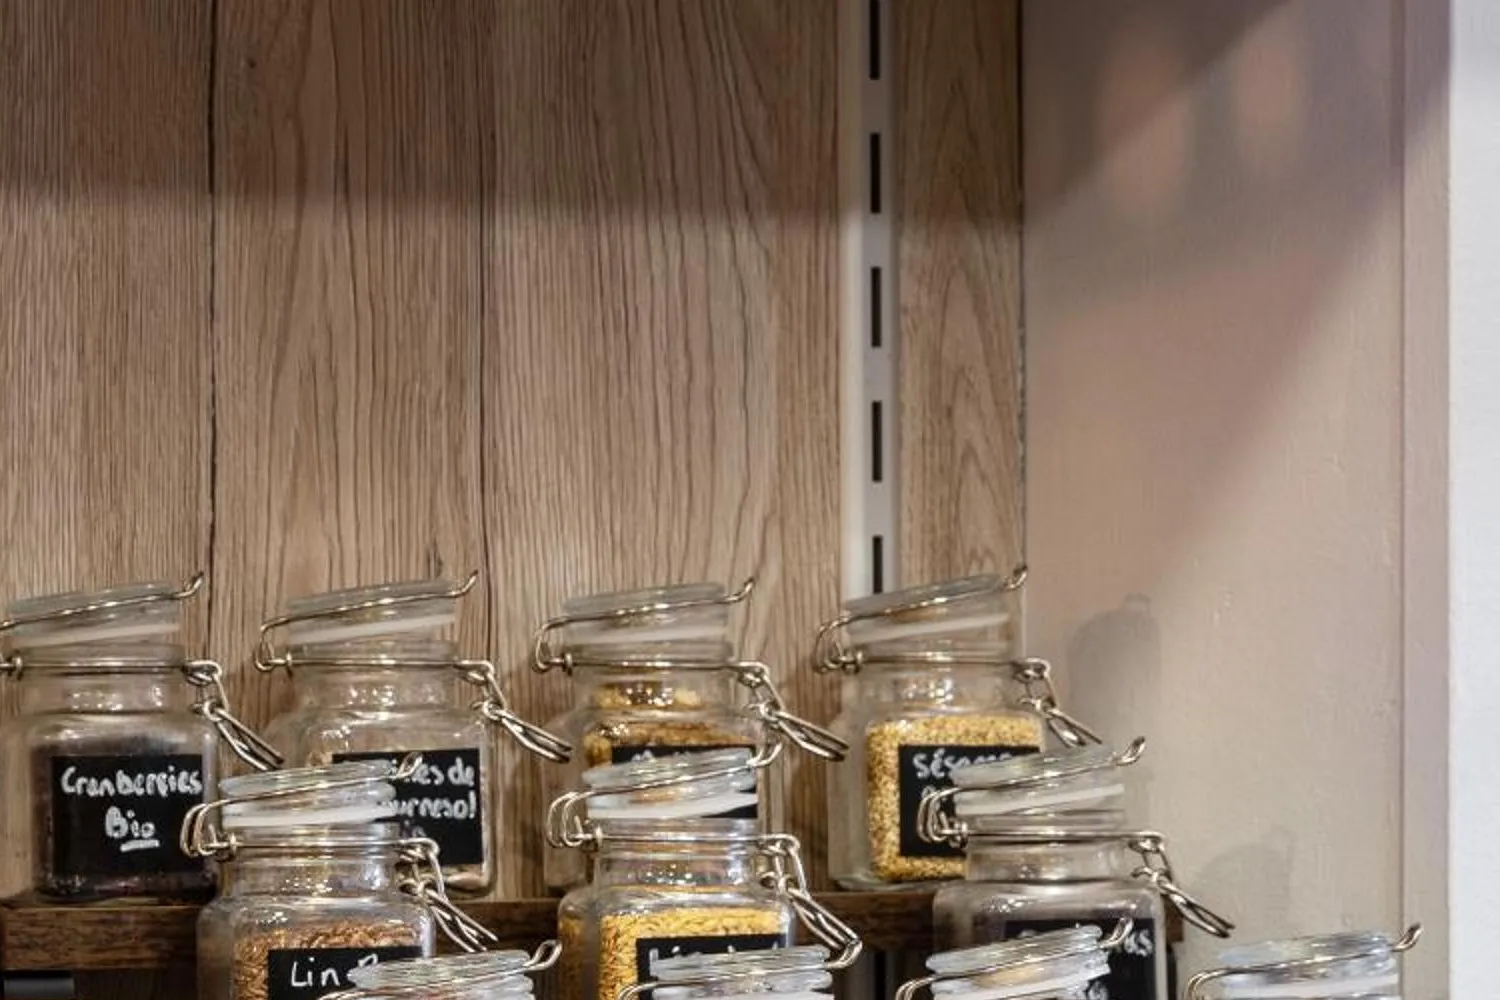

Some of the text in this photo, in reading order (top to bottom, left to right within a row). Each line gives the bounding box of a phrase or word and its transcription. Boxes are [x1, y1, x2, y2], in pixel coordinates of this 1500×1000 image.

[61, 765, 203, 797] Cranberries
[447, 756, 475, 787] de
[105, 805, 156, 839] Bio
[290, 956, 341, 987] Lin
